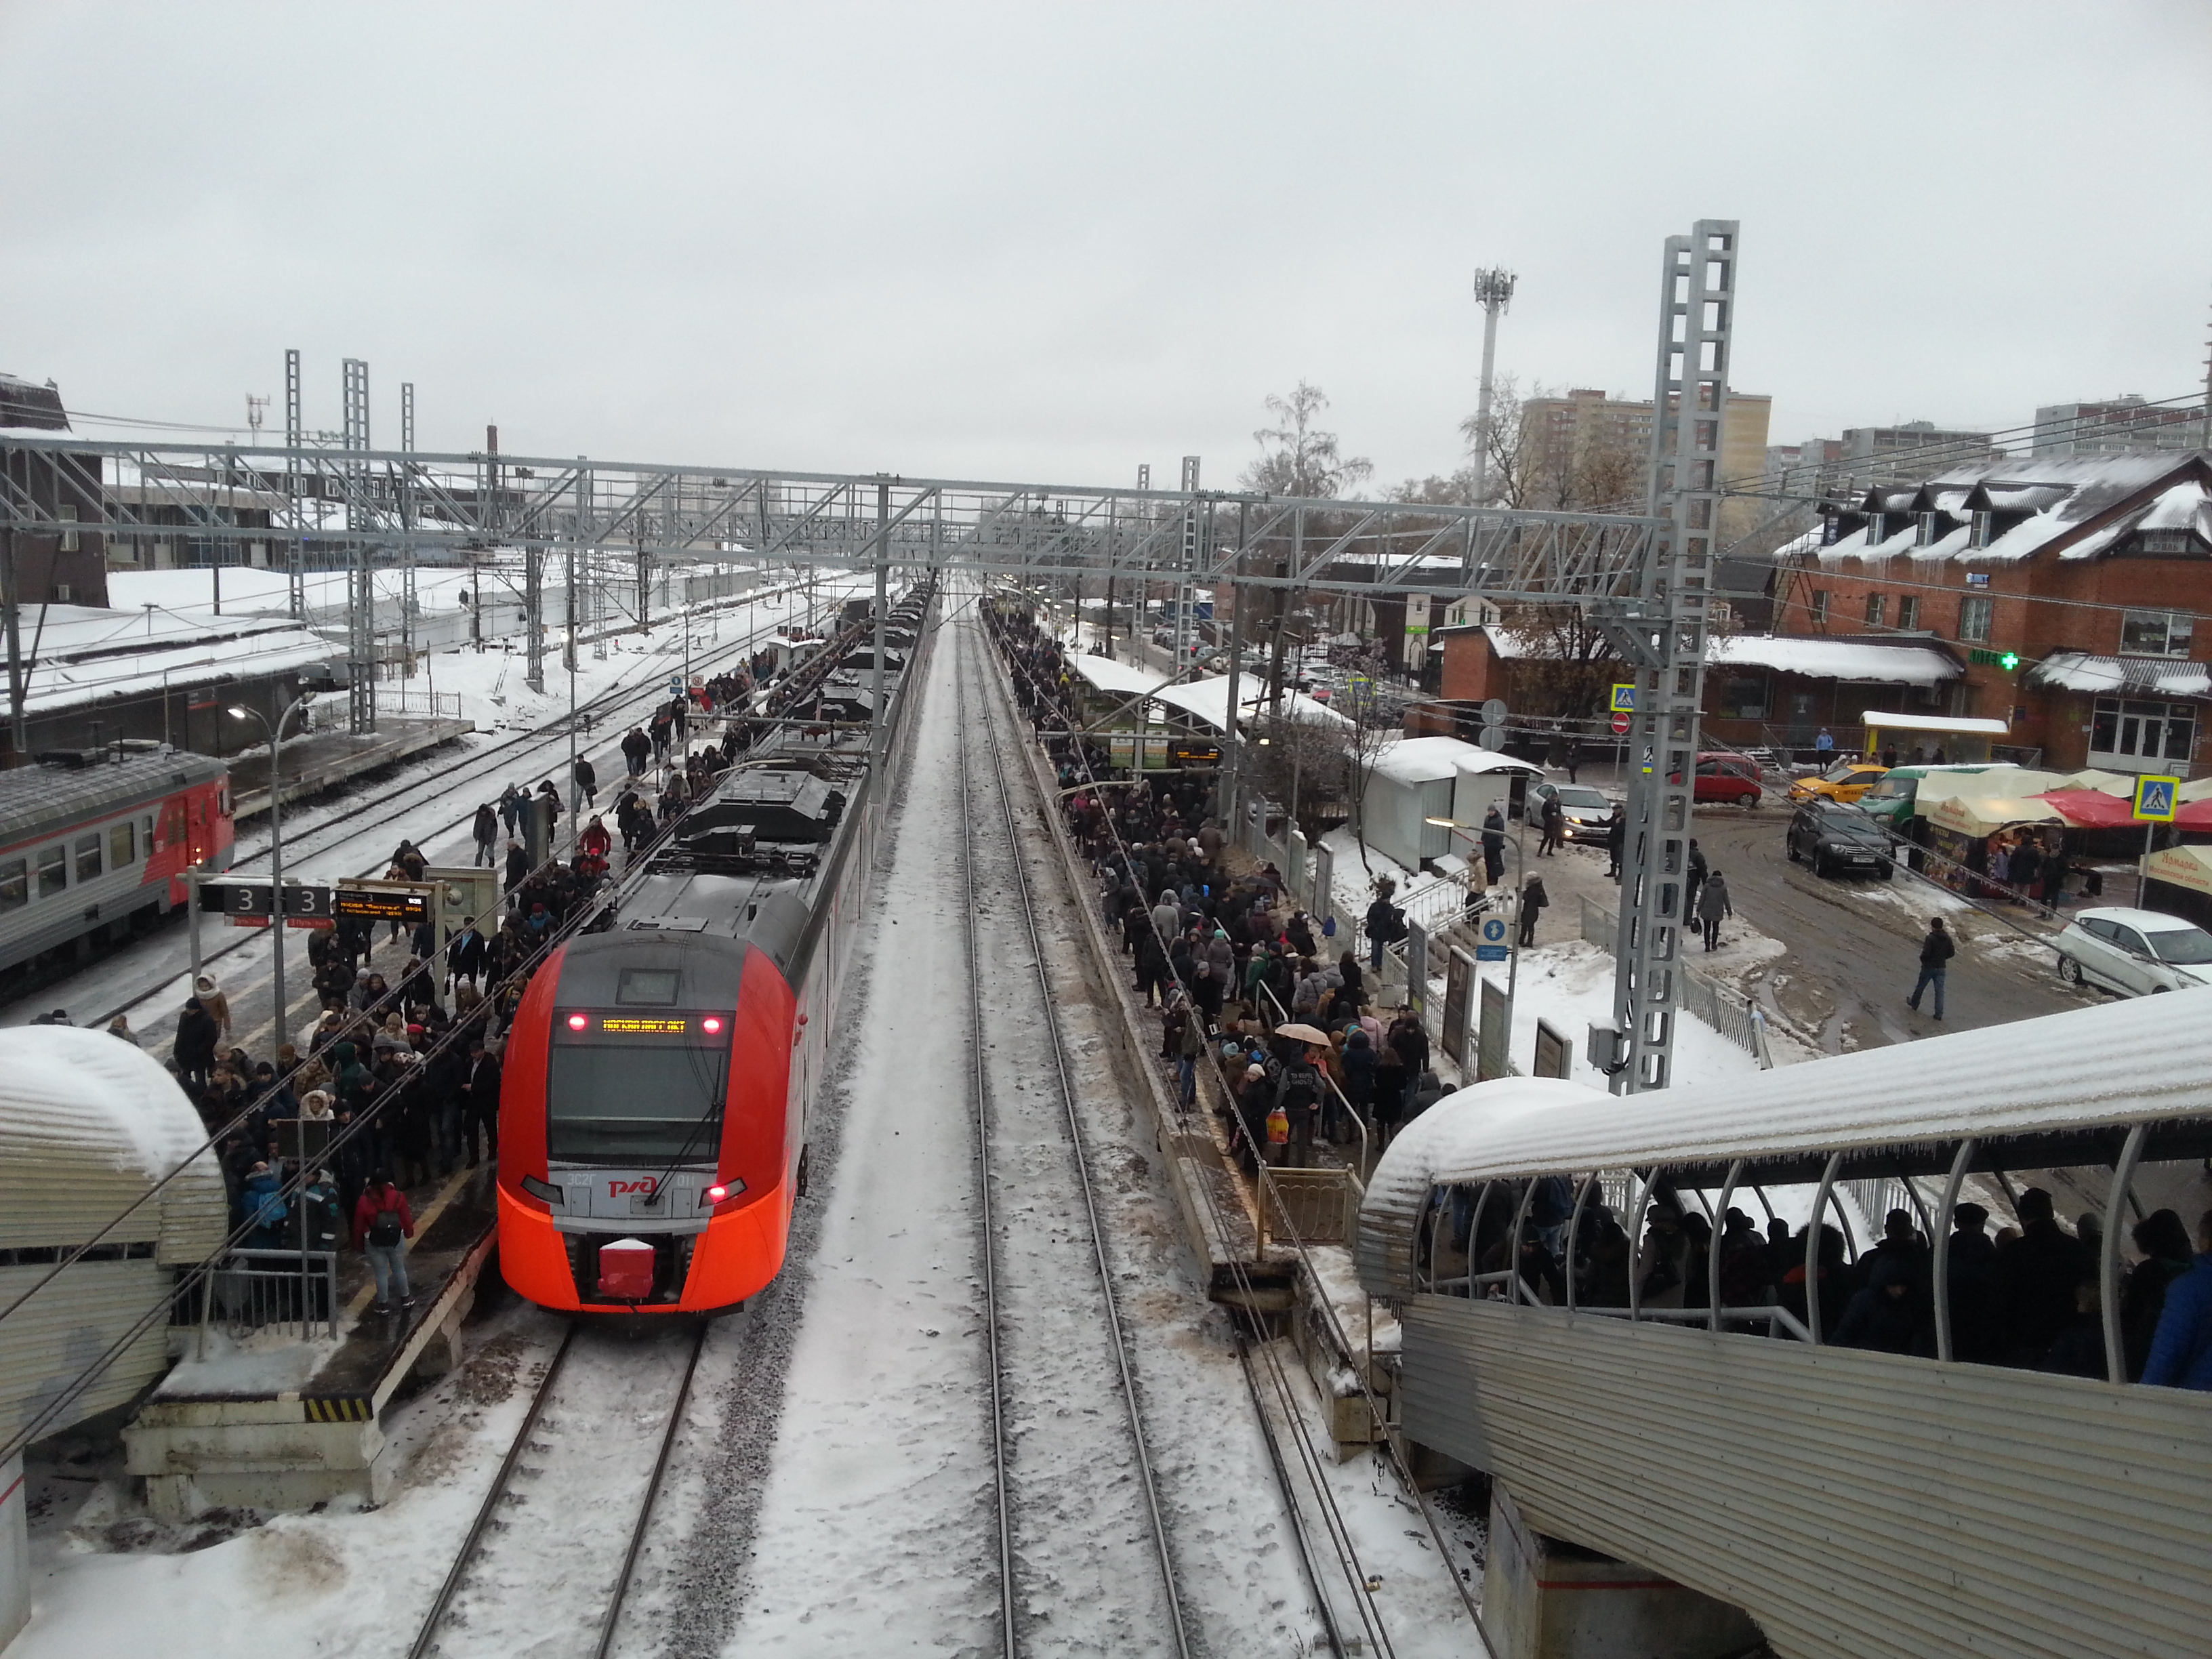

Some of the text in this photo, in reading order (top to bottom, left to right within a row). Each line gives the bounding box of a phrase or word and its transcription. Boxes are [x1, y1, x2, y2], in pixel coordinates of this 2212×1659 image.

[2162, 851, 2199, 872] Ярмарка
[2149, 865, 2209, 886] Московской области
[239, 889, 253, 910] 3
[301, 890, 316, 912] 3
[567, 1173, 596, 1185] ЭС2Г
